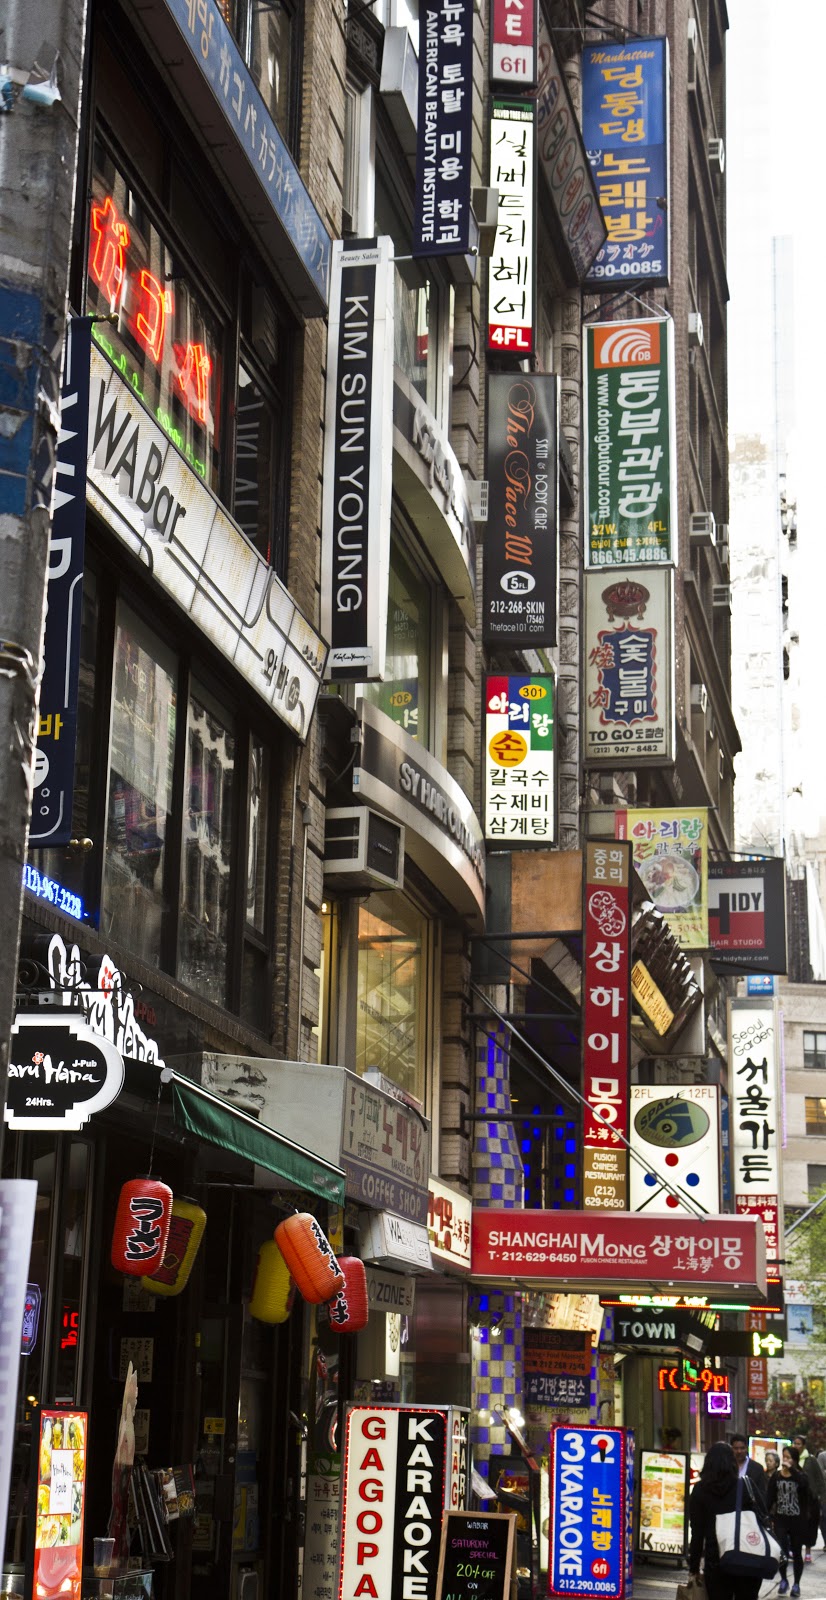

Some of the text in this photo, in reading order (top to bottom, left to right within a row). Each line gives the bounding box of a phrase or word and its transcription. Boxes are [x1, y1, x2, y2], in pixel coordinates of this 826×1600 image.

[590, 49, 656, 63] Manhattan
[599, 64, 646, 142] 딩동댕
[493, 108, 510, 120] SILVER
[521, 111, 533, 122] HAIR
[422, 10, 438, 242] AMERICAN BEAUTY INSTITUTE
[438, 130, 462, 181] 미용
[596, 153, 652, 243] 노래방
[436, 199, 462, 244] 학교
[339, 252, 380, 263] Beauty Salon
[491, 327, 529, 347] 4FL
[638, 351, 651, 362] DB
[535, 438, 548, 460] SKIN
[594, 373, 610, 519] www.dongbutour.com
[617, 369, 664, 519] 동부관광
[92, 376, 187, 544] WABar
[336, 296, 368, 613] KIM SUN YOUNG
[504, 380, 537, 566] The Face 101
[534, 506, 548, 531] CARE
[591, 547, 668, 564] 866.945.4886
[490, 600, 545, 615] 212-268-SKIN
[525, 614, 545, 625] (7546)
[522, 687, 543, 698] 301
[488, 691, 554, 738] 아리랑
[614, 699, 648, 717] 구이
[589, 728, 608, 742] TO
[611, 728, 634, 742] GO
[492, 733, 524, 763] 손
[593, 745, 611, 754] (212)
[489, 769, 549, 788] 칼국수
[399, 762, 448, 825] SY HAIR
[489, 793, 549, 812] 수제비
[489, 817, 549, 836] 삼계탕
[632, 818, 704, 840] 아리랑
[593, 848, 624, 866] 중화
[593, 866, 624, 883] 요리
[588, 941, 625, 1125] 상하이몽
[732, 1019, 764, 1044] Seoul
[733, 1027, 775, 1057] Garden
[43, 1054, 101, 1084] Hana
[72, 1059, 98, 1069] J-Pub
[25, 1097, 55, 1107] 24Hrs.
[689, 1088, 714, 1099] 12FL
[737, 1057, 775, 1183] 서울가든
[585, 1126, 624, 1144] 上海夢
[592, 1162, 618, 1171] CHINESE
[594, 1153, 617, 1162] FUSION
[585, 1171, 625, 1181] RESTAURANT
[361, 1173, 395, 1206] COFFEE
[399, 1189, 422, 1218] SHOP
[594, 1186, 616, 1197] (212)
[585, 1197, 624, 1209] 629-6450
[125, 1197, 164, 1261] ラーメン
[488, 1230, 646, 1258] SHANGHAI MONG
[649, 1235, 743, 1270] 상하이몽
[673, 1257, 714, 1274] 上海夢
[619, 1321, 677, 1340] TOWN
[354, 1416, 387, 1599] GAGOPA
[402, 1418, 434, 1600] KARAOKE
[466, 1521, 489, 1530] WABAR
[559, 1464, 584, 1577] KARAOKE
[591, 1487, 613, 1551] 노래방
[451, 1538, 490, 1549] SATURDAY
[654, 1540, 683, 1554] TOWN
[469, 1551, 500, 1560] SPECIAL
[456, 1564, 496, 1580] 20% OFF
[467, 1582, 479, 1590] ON
[559, 1578, 616, 1593] 212.290.0085
